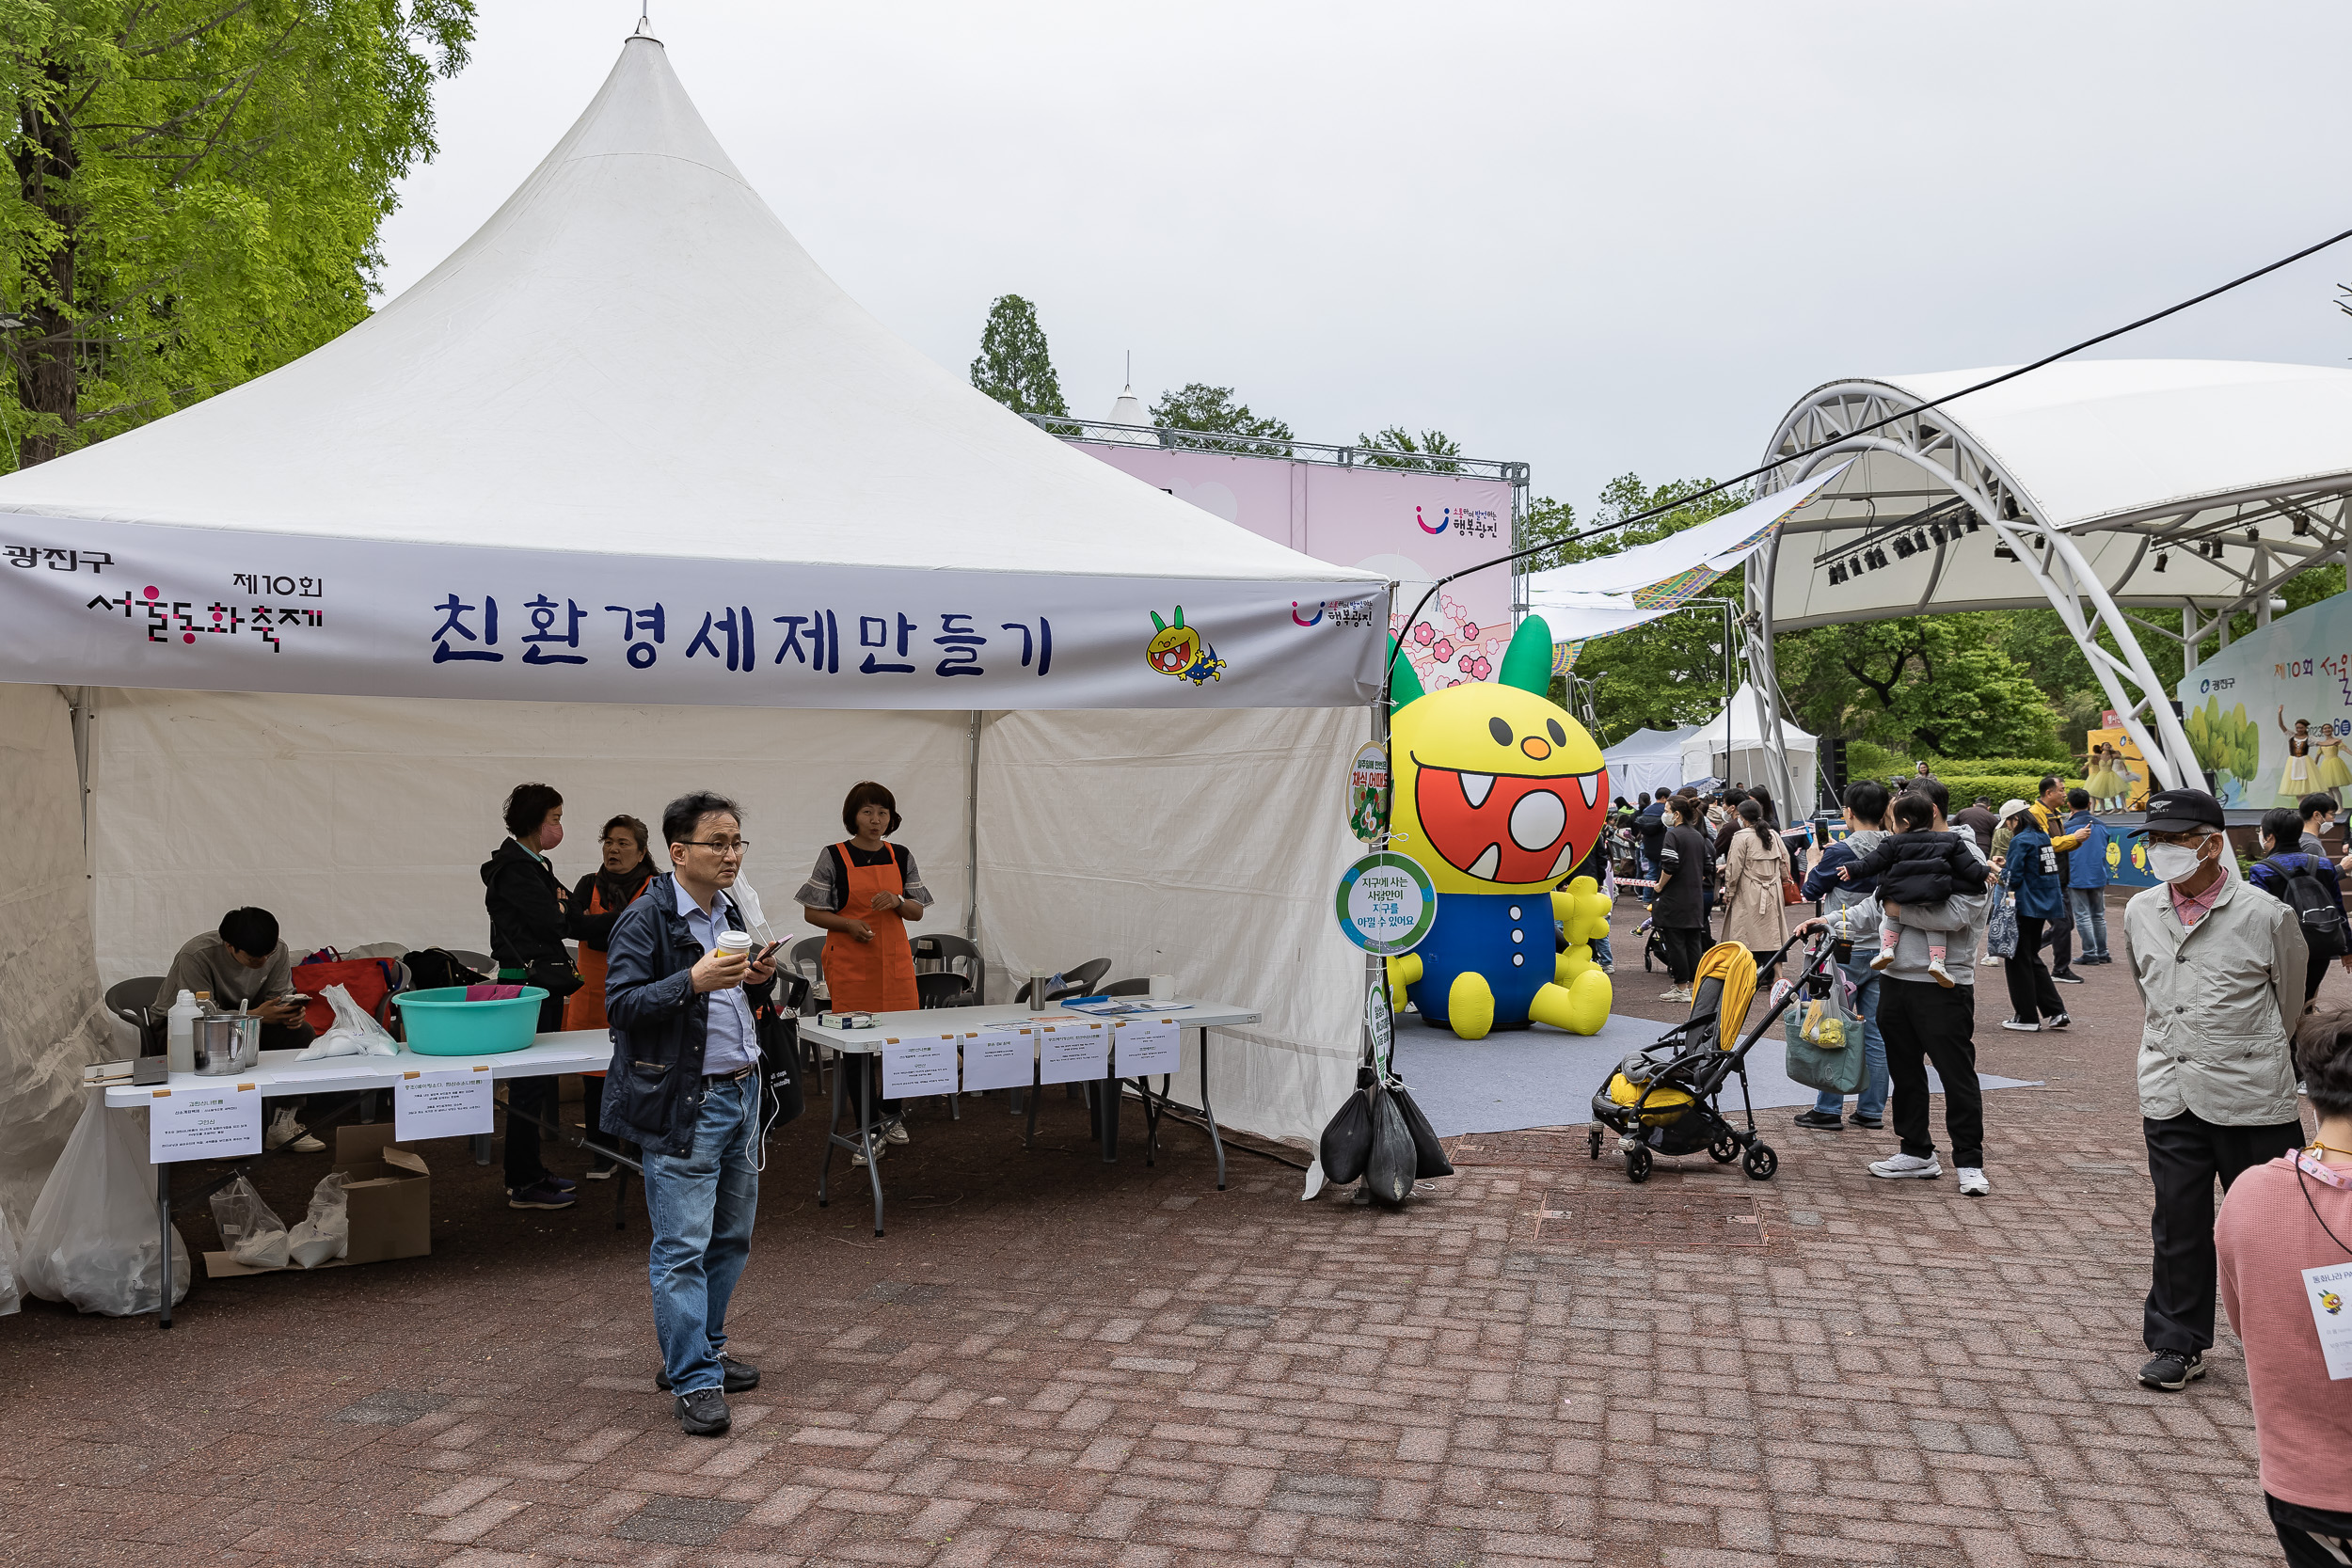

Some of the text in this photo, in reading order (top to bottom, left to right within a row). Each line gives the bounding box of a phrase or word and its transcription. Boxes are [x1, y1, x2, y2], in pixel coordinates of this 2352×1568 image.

[1453, 508, 1497, 520] 소통하며 발전하는
[1453, 518, 1497, 538] 행복광진
[2, 545, 115, 574] 광진구
[232, 573, 323, 597] 제10회
[87, 585, 323, 653] 서울동화축제
[1327, 610, 1373, 627] 행복광진
[2212, 678, 2235, 691] 광진구
[2274, 654, 2352, 705] 제10회 서울
[1352, 771, 1367, 787] 채식
[1361, 876, 1408, 889] 지구에 사는
[1367, 889, 1403, 901] 사람만이
[1373, 903, 1399, 914] 지구를
[1357, 915, 1414, 927] 아낄 수 있어요
[2312, 1272, 2343, 1284] 동화나라
